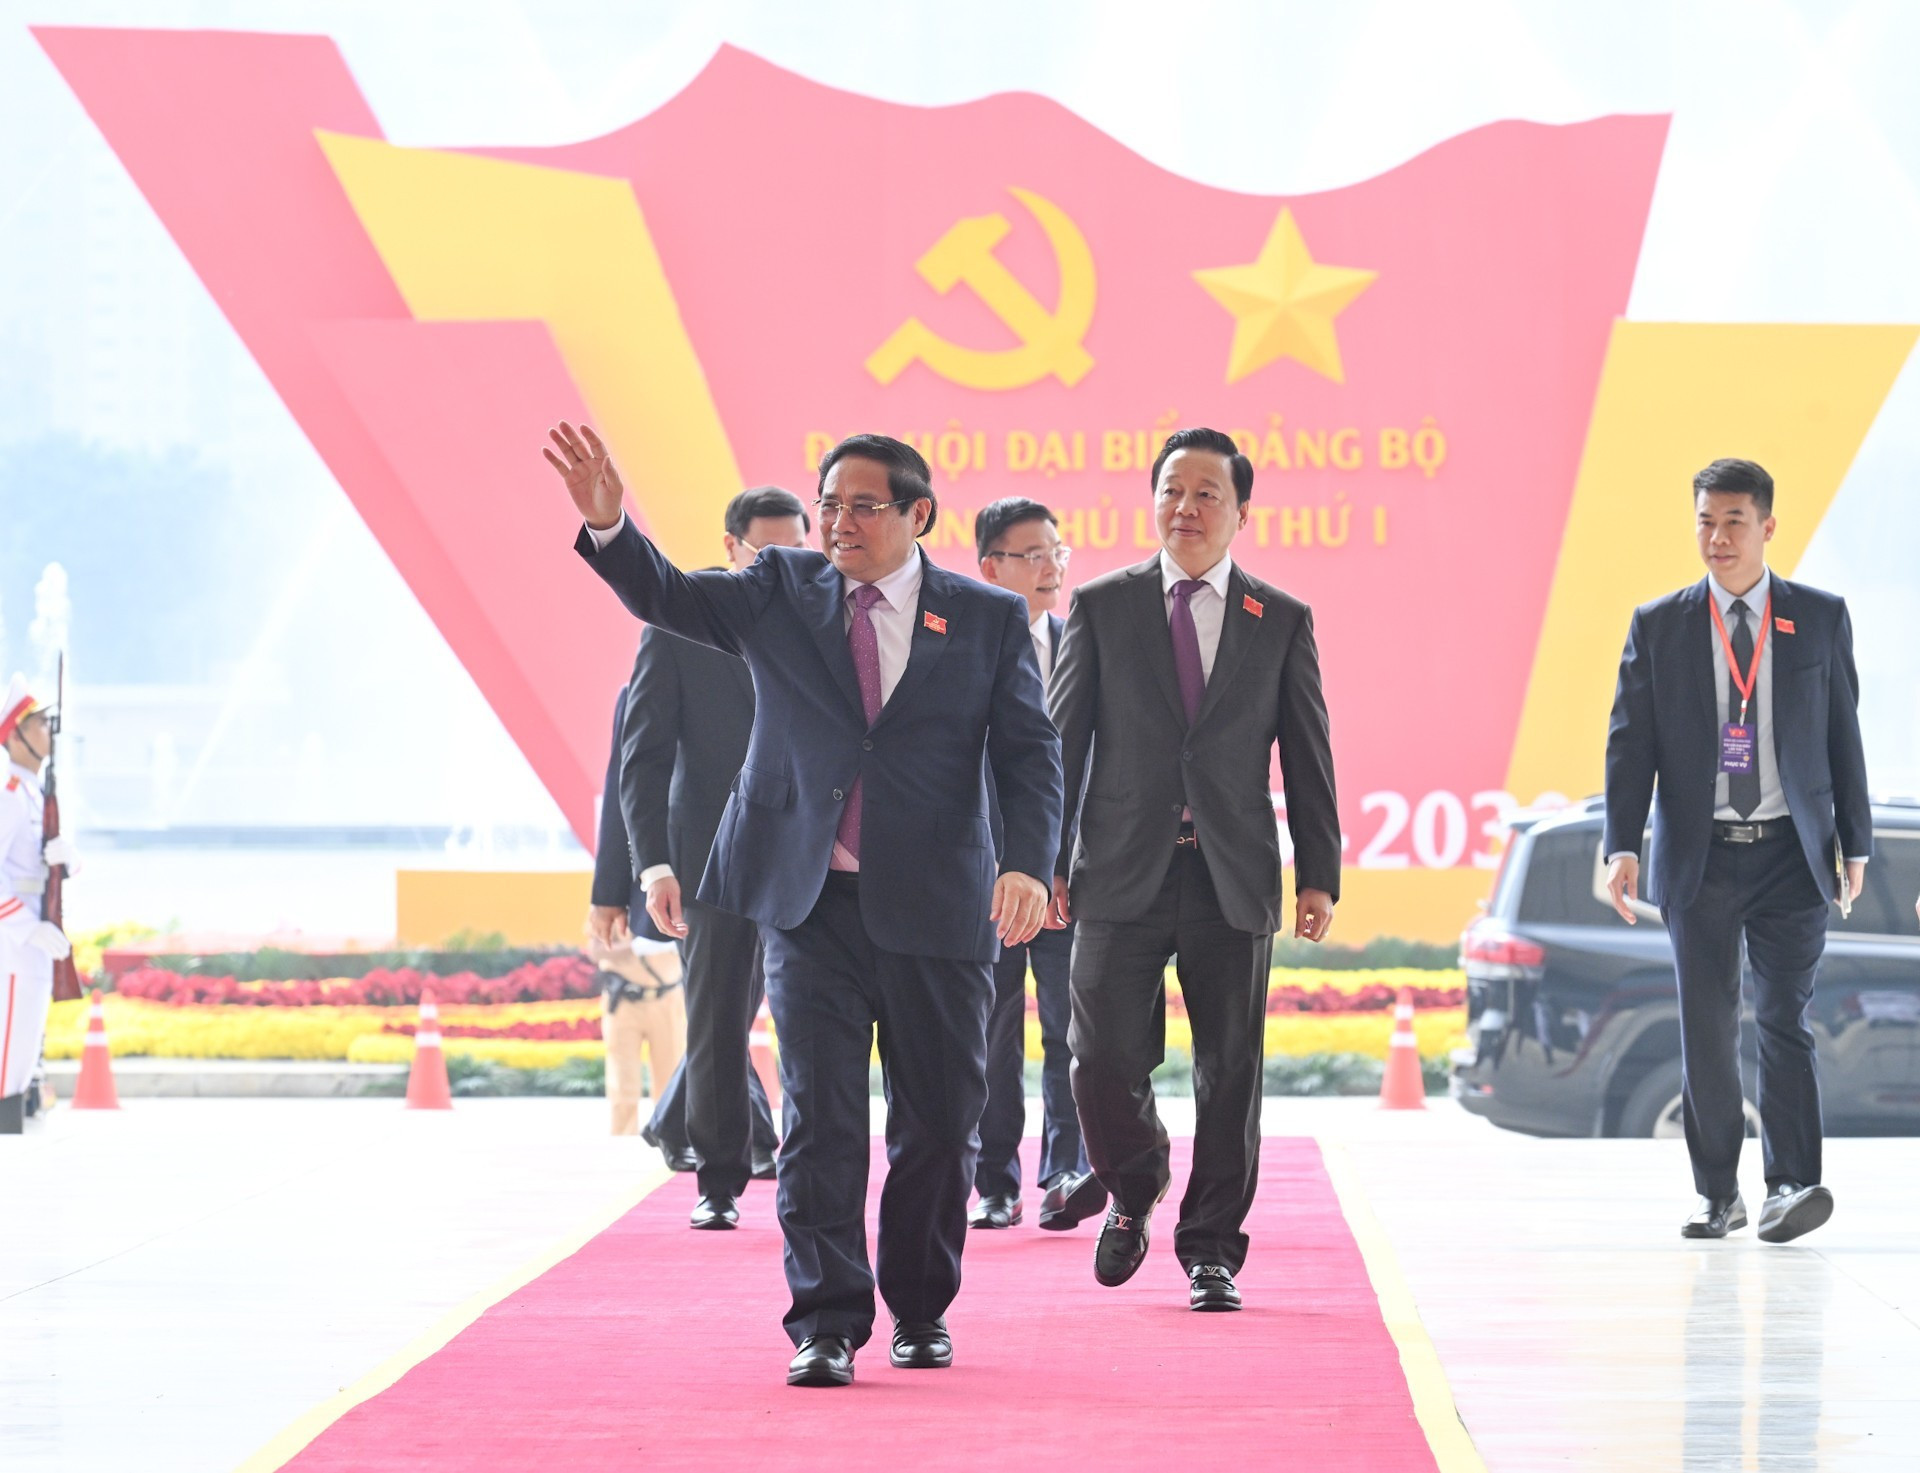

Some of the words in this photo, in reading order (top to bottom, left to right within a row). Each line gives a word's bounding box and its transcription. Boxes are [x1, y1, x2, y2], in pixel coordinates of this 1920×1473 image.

[1007, 429, 1085, 480] ĐẠI
[1379, 416, 1446, 479] BỘ
[1055, 494, 1118, 549] HỦ
[1251, 491, 1352, 548] THỨ
[1374, 505, 1387, 546] I
[1358, 790, 1570, 869] 203
